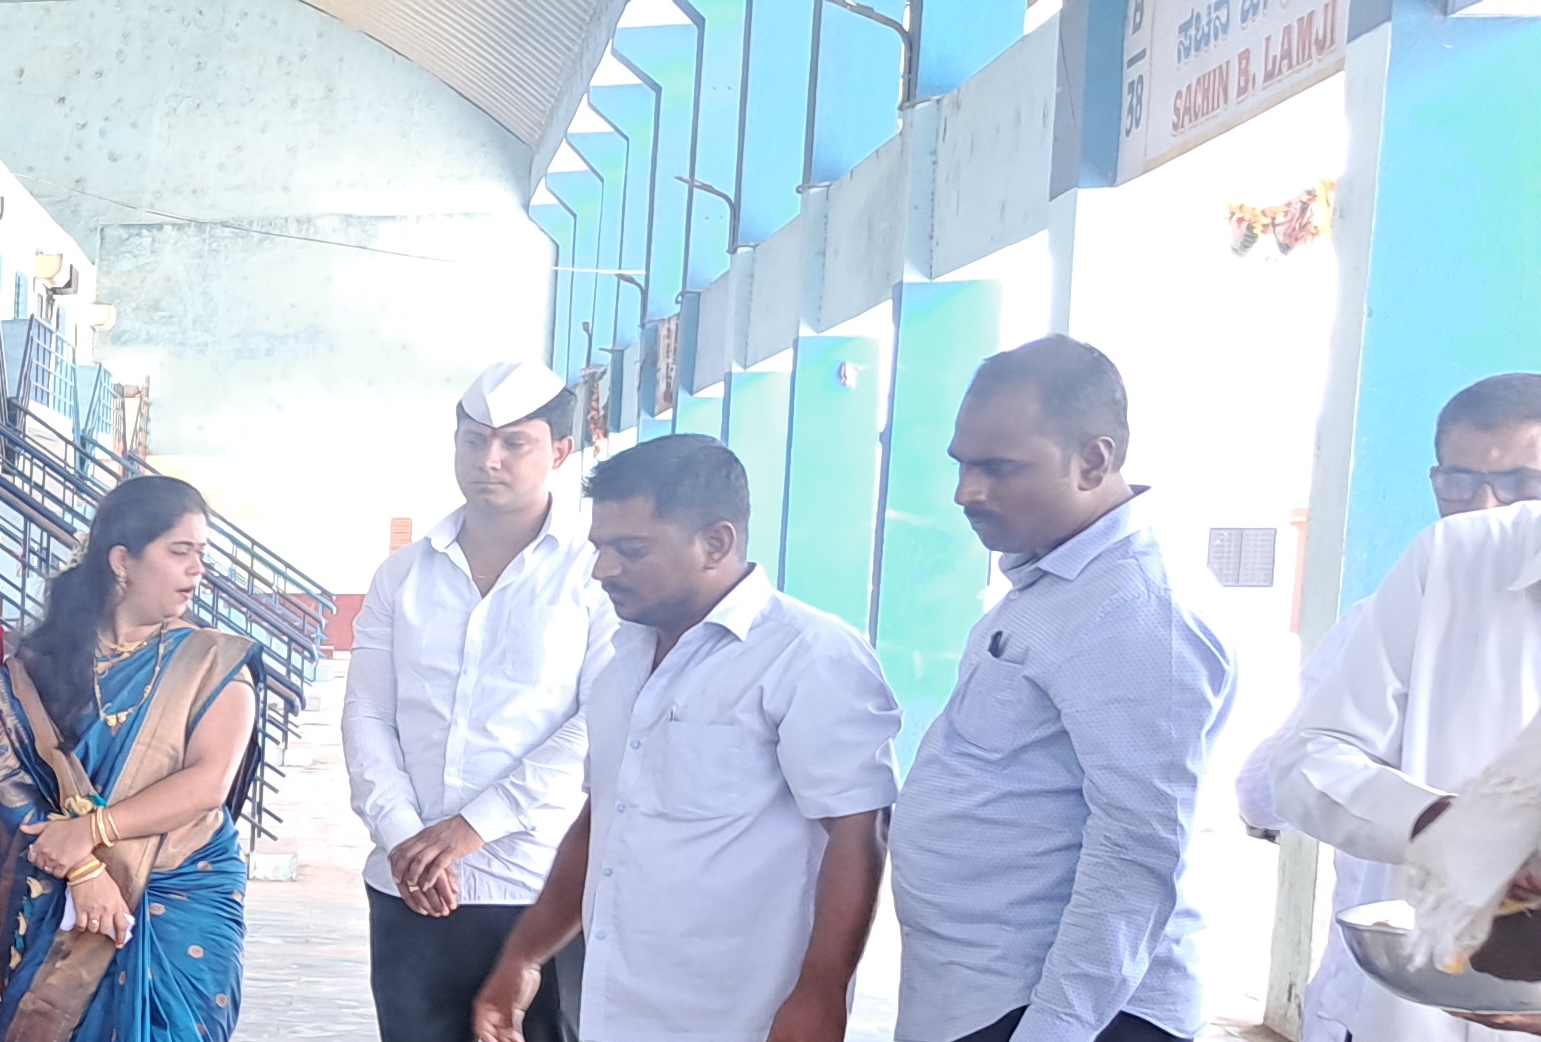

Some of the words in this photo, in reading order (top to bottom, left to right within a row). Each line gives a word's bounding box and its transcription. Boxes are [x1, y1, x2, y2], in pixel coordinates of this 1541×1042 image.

[1125, 74, 1144, 137] 38
[1172, 60, 1230, 133] SACHIN
[1237, 48, 1256, 99] B.
[1262, 0, 1337, 84] LAMJI
